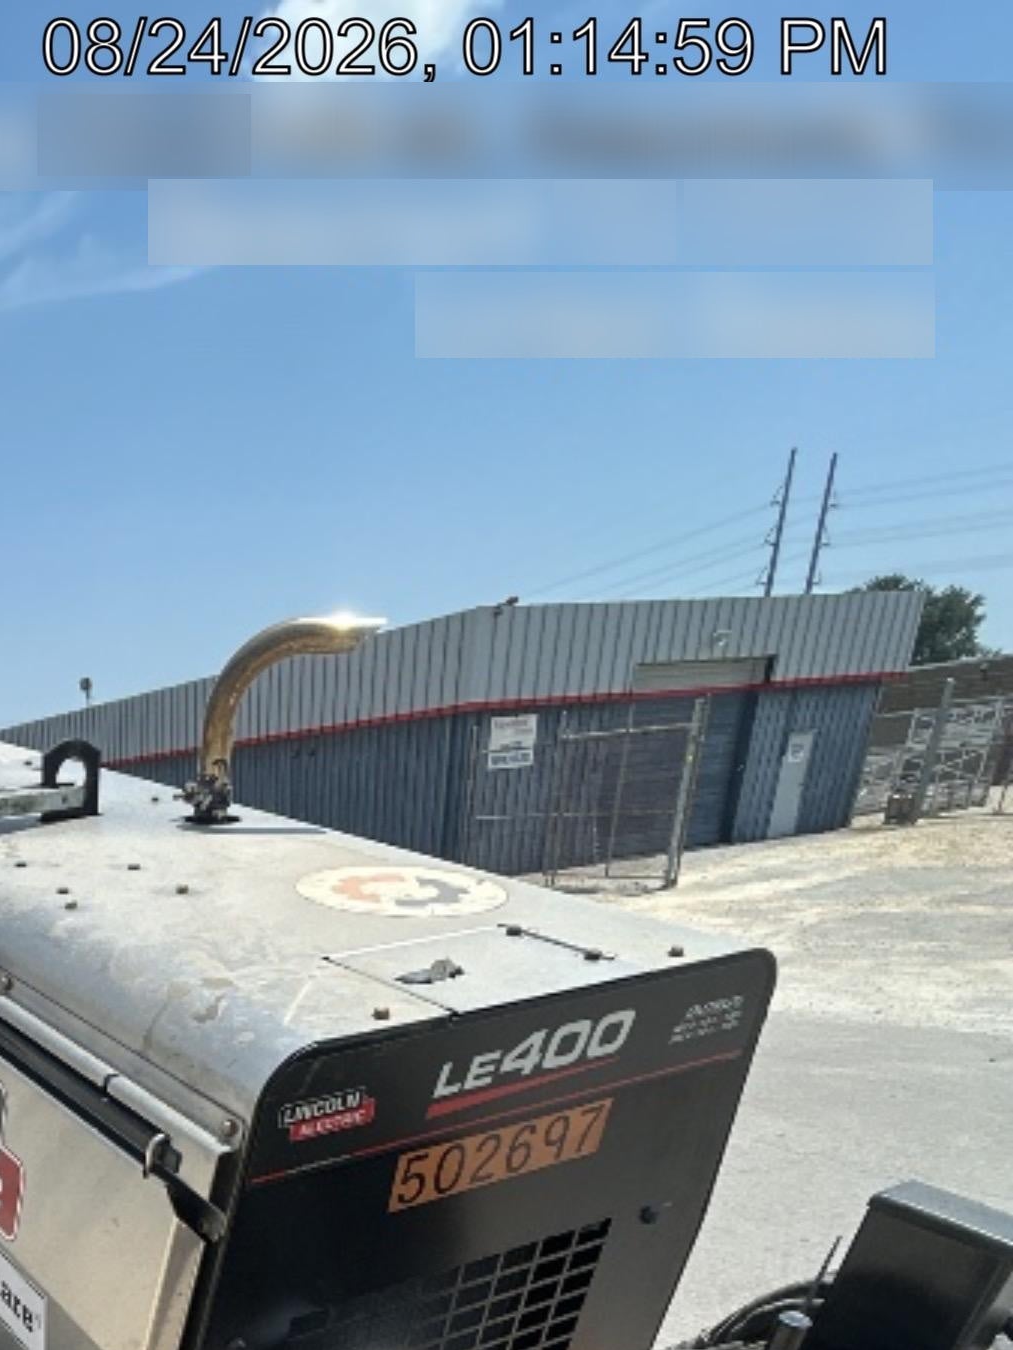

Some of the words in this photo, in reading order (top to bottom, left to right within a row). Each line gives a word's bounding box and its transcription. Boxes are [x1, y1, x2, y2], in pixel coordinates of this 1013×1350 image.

[433, 1009, 636, 1098] LE400
[283, 1089, 361, 1125] LINCOLN
[397, 1103, 606, 1206] 502697
